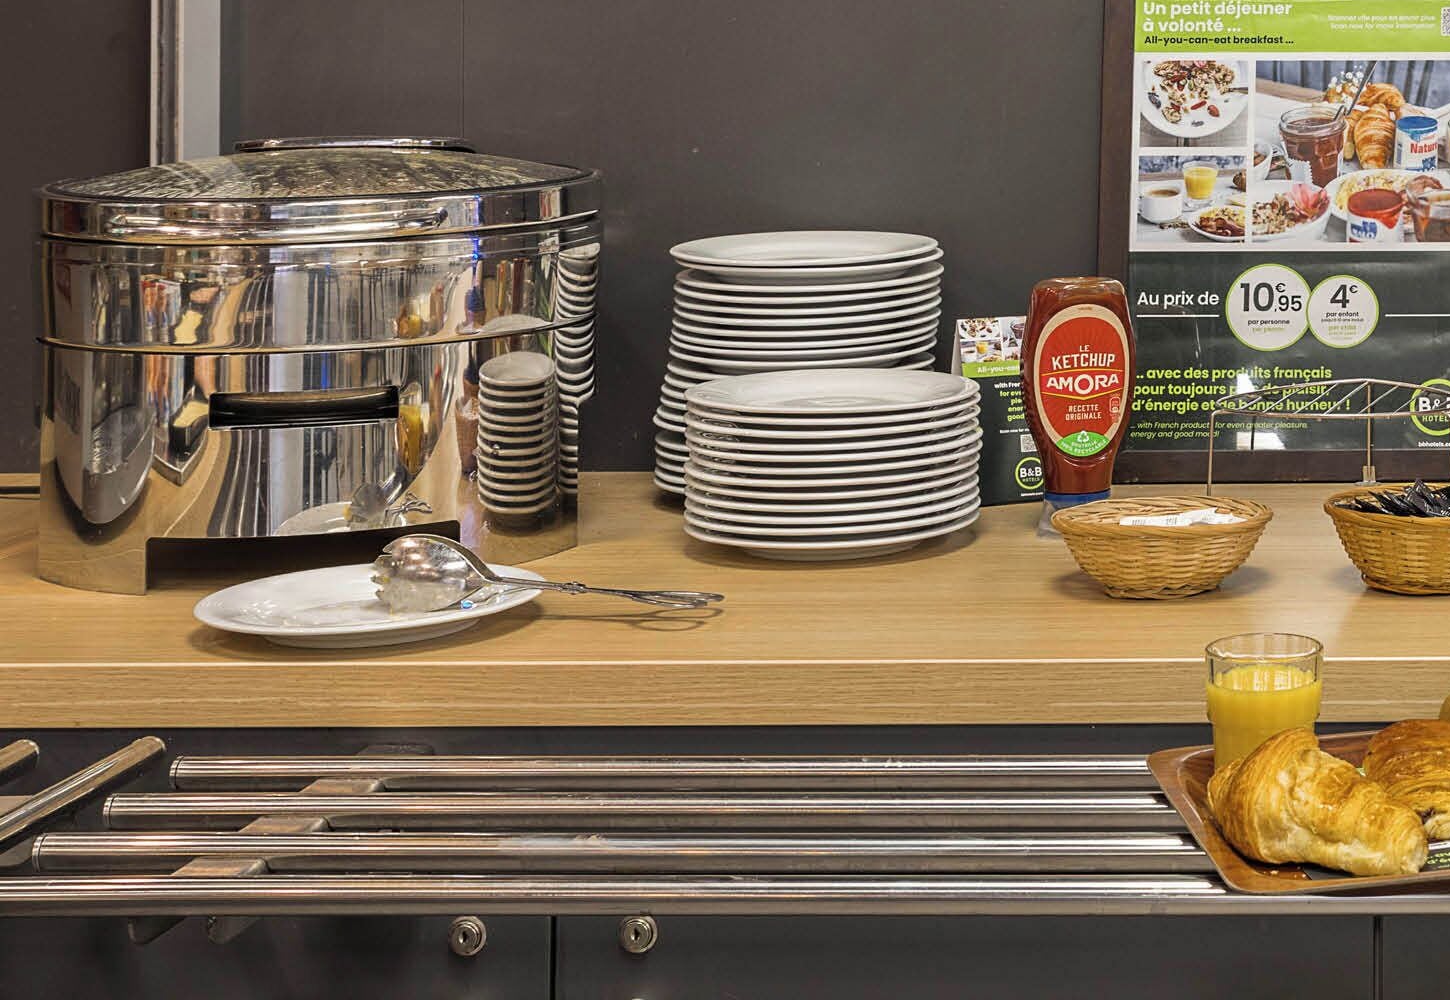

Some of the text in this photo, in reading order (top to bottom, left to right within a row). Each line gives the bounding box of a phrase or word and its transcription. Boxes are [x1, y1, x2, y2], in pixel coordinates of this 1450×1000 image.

[1143, 0, 1293, 18] Un petit déjeuner
[1143, 18, 1154, 32] à
[1158, 18, 1224, 32] volonté
[1144, 36, 1231, 47] All-you-can-eat
[1233, 36, 1284, 44] breakfast
[1137, 290, 1220, 310] Au prix de
[1051, 353, 1115, 370] KETCHUP
[1146, 369, 1181, 379] avec
[1184, 367, 1209, 379] des
[1273, 366, 1332, 382] français
[1046, 374, 1119, 395] AMORA
[1133, 385, 1166, 398] pour
[1167, 383, 1226, 398] toujours
[1068, 404, 1099, 412] RECETTE
[1132, 399, 1198, 414] d'énergie
[1201, 400, 1215, 411] et
[1286, 399, 1341, 411] humeu
[1346, 399, 1351, 410] !
[1065, 412, 1102, 421] ORIGINALE
[1180, 422, 1212, 430] product
[1130, 431, 1157, 439] energy
[1173, 431, 1195, 439] good
[1020, 467, 1042, 478] B&B
